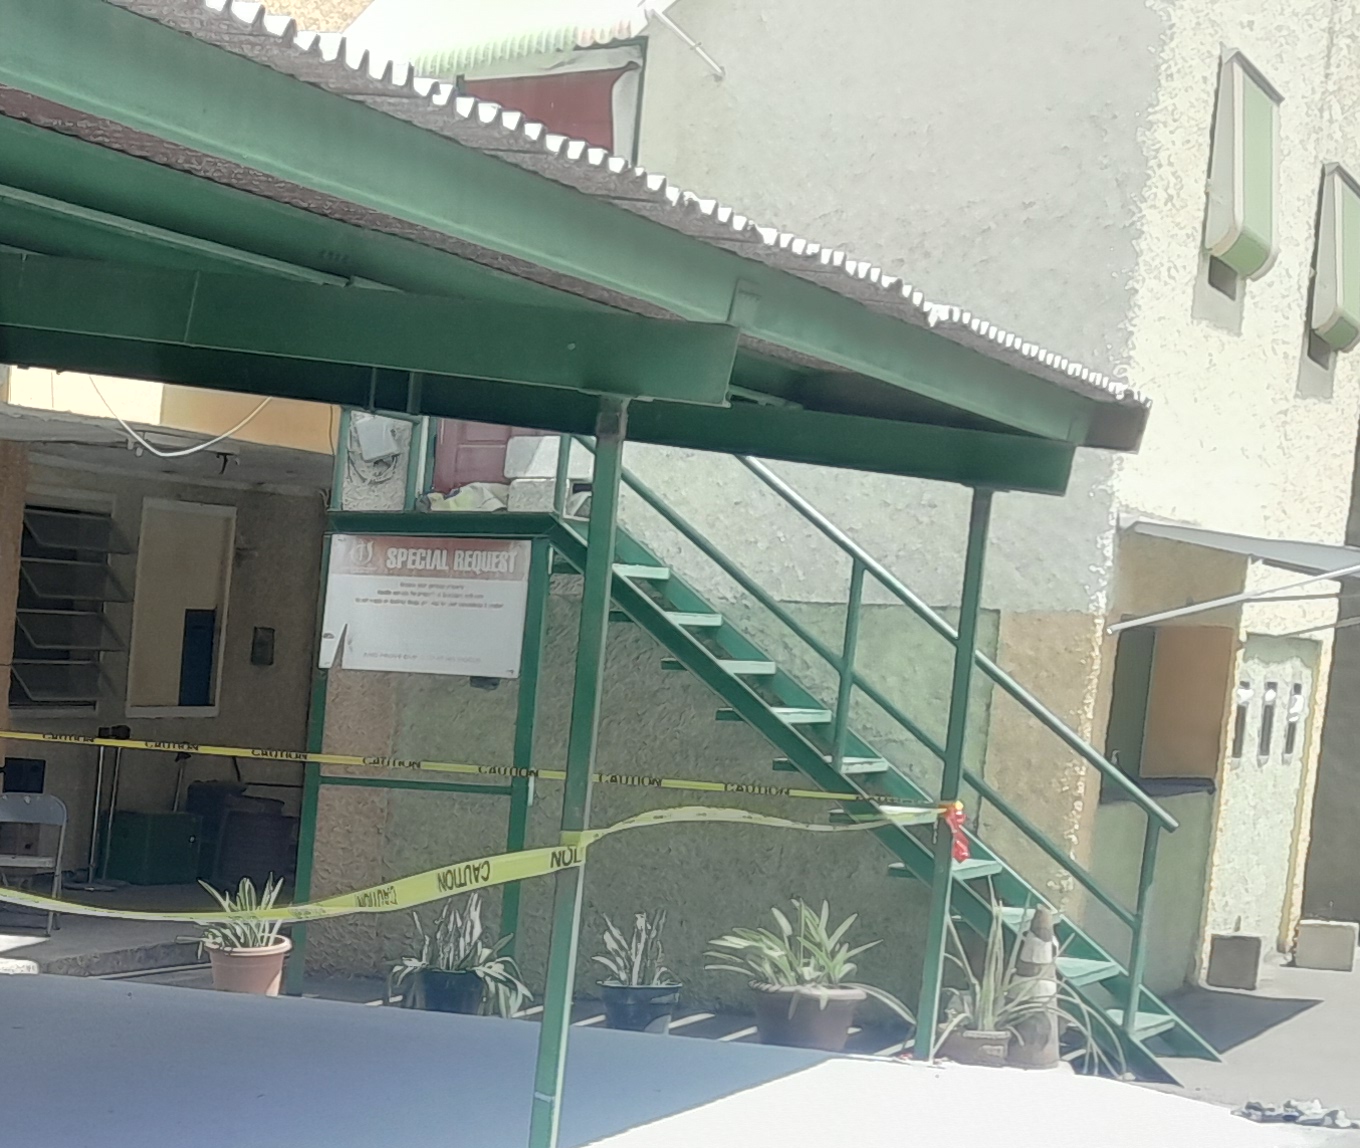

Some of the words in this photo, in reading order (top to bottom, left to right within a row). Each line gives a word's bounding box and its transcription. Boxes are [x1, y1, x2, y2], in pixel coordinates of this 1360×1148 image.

[386, 547, 449, 571] SPECIAL
[453, 549, 518, 575] REQUEST
[437, 860, 490, 893] CAUTION
